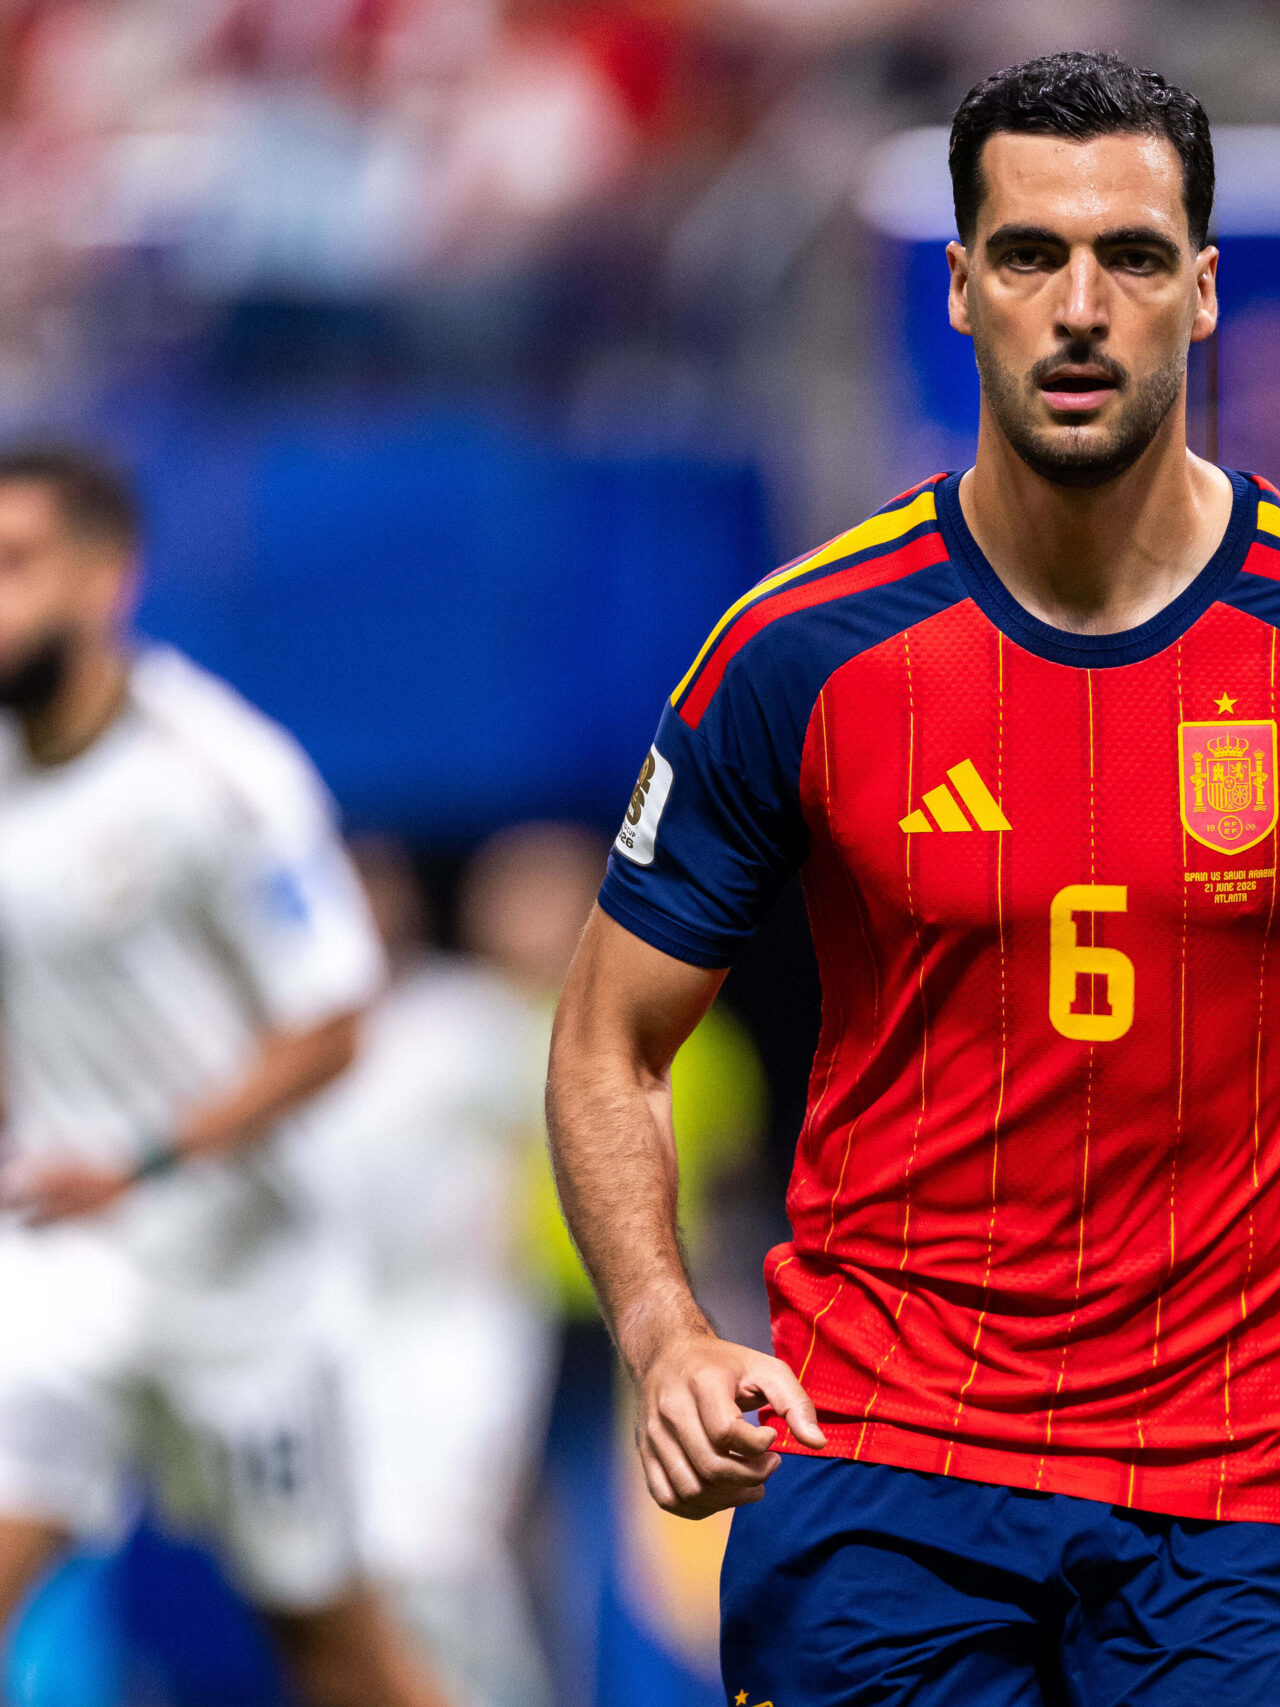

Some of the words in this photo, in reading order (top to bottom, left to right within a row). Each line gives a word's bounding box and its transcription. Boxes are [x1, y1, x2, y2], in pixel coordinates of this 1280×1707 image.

[1185, 872, 1208, 882] SPAIN
[1223, 870, 1246, 880] SAUDI
[1248, 868, 1275, 879] ARABIA
[1204, 883, 1214, 893] 21
[1215, 882, 1234, 892] JUNE
[1236, 881, 1257, 891] 2026
[1213, 893, 1247, 904] ATLANTA
[1049, 884, 1135, 1042] 6
